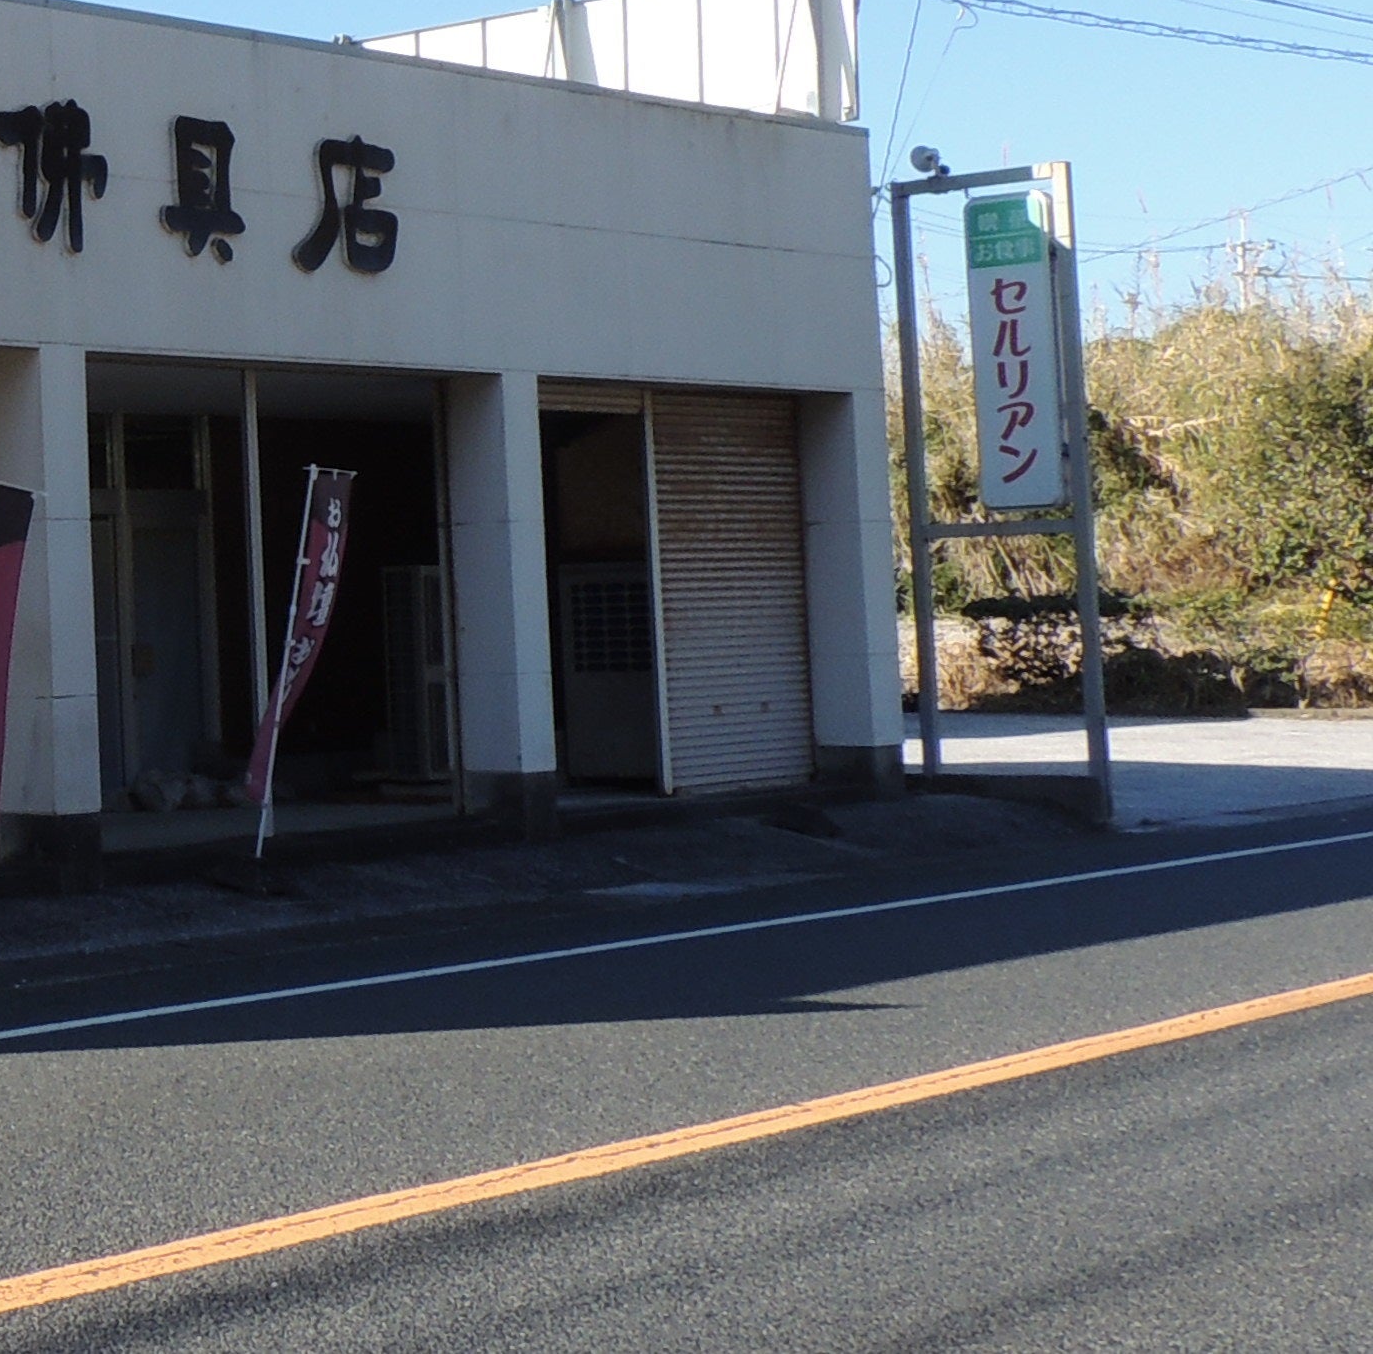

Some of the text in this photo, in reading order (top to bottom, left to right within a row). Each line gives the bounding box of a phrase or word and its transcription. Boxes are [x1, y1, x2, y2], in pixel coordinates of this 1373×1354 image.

[990, 277, 1039, 484] セルリアン
